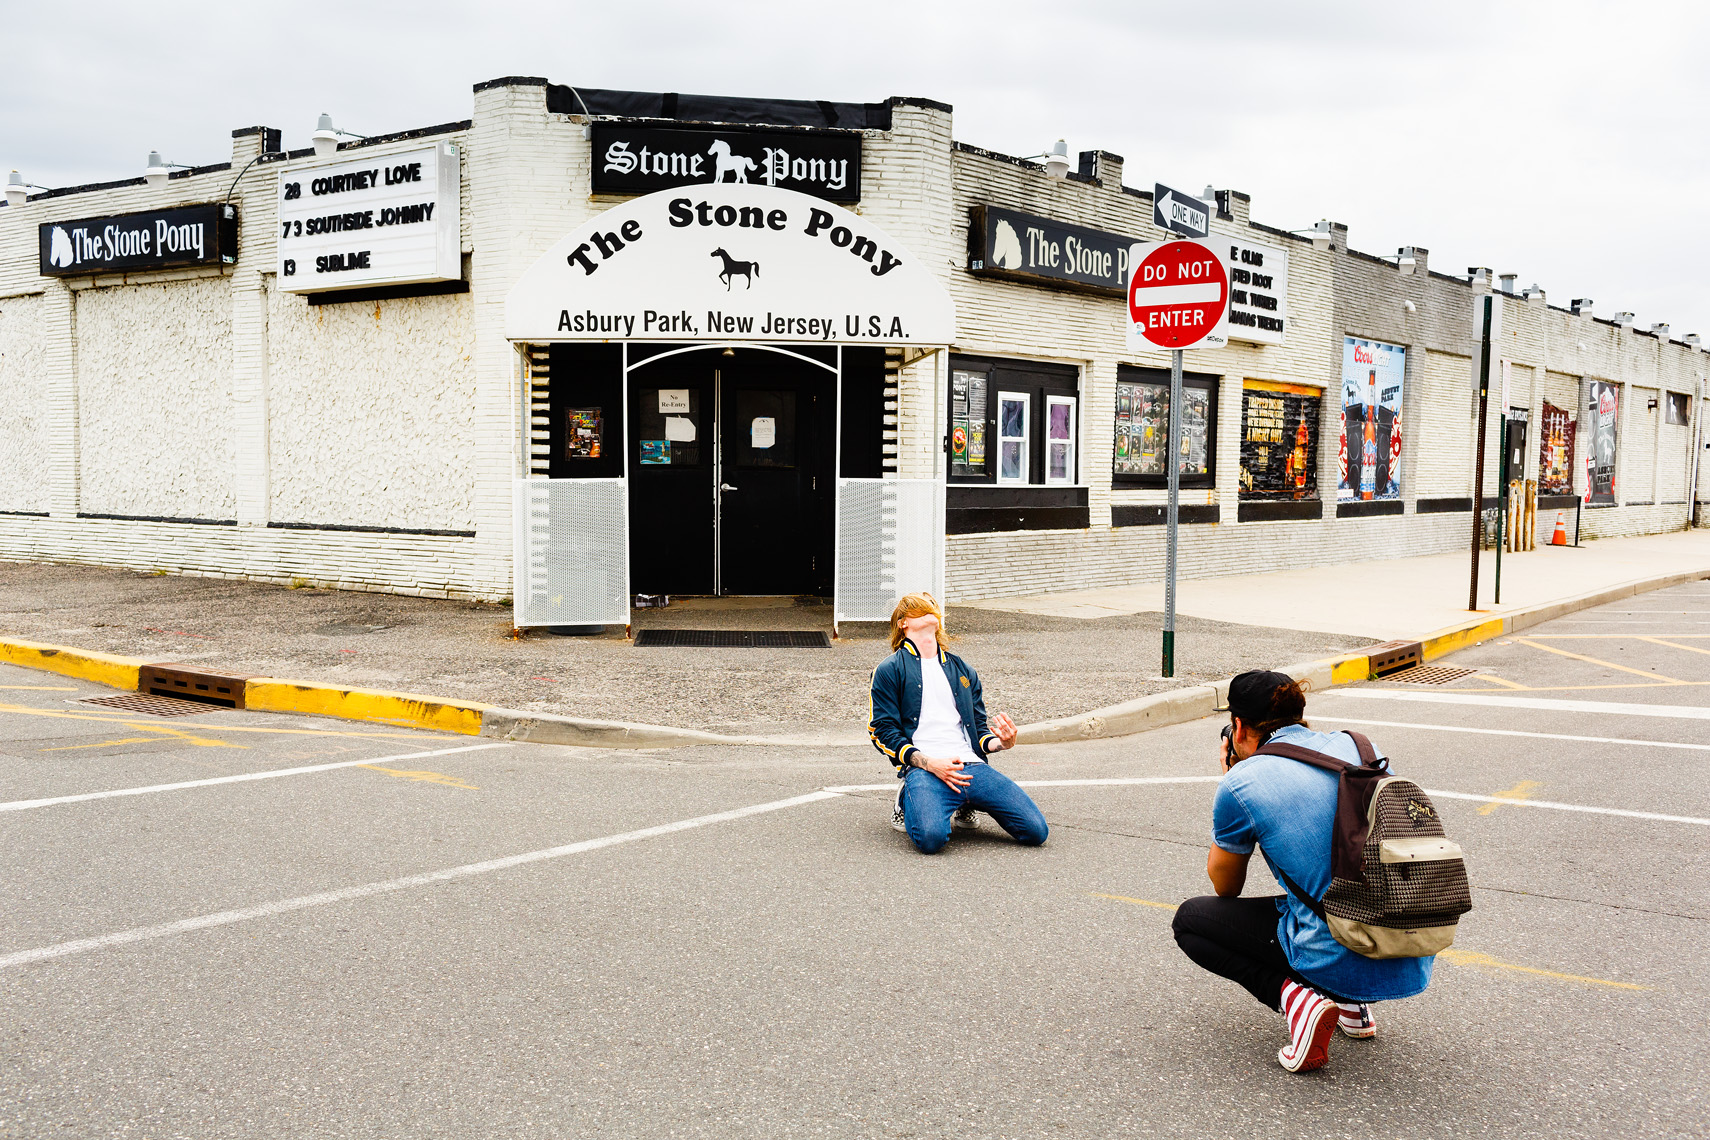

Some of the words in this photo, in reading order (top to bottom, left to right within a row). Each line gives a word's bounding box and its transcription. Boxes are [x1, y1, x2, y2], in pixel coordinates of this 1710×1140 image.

[604, 141, 706, 177] Stone
[760, 147, 848, 190] Pony
[284, 181, 301, 200] 28
[311, 169, 379, 196] COURTNEY
[385, 162, 421, 185] LOVE
[306, 210, 373, 235] SOUTHSIDE
[375, 202, 435, 227] JOHNNY
[1171, 203, 1188, 223] ONE
[1189, 208, 1206, 230] WAY
[72, 228, 102, 264] The
[104, 224, 150, 261] Stone
[155, 219, 204, 259] Pony
[567, 219, 643, 277] The
[668, 198, 788, 231] Stone
[803, 207, 903, 277] Pony
[1026, 226, 1060, 268] The
[1064, 235, 1112, 278] Stone
[284, 259, 296, 276] 13
[316, 250, 371, 273] SUBLIME
[1144, 264, 1167, 282] DO
[1178, 260, 1213, 279] NOT
[1232, 268, 1251, 285] STED
[1252, 272, 1273, 289] ROOT
[1232, 289, 1248, 305] ANK
[557, 310, 635, 337] Asbury
[643, 310, 699, 336] Park,
[707, 311, 755, 334] New
[761, 312, 837, 340] Jersey,
[845, 315, 911, 339] U.S.A.
[1149, 309, 1204, 328] ENTER
